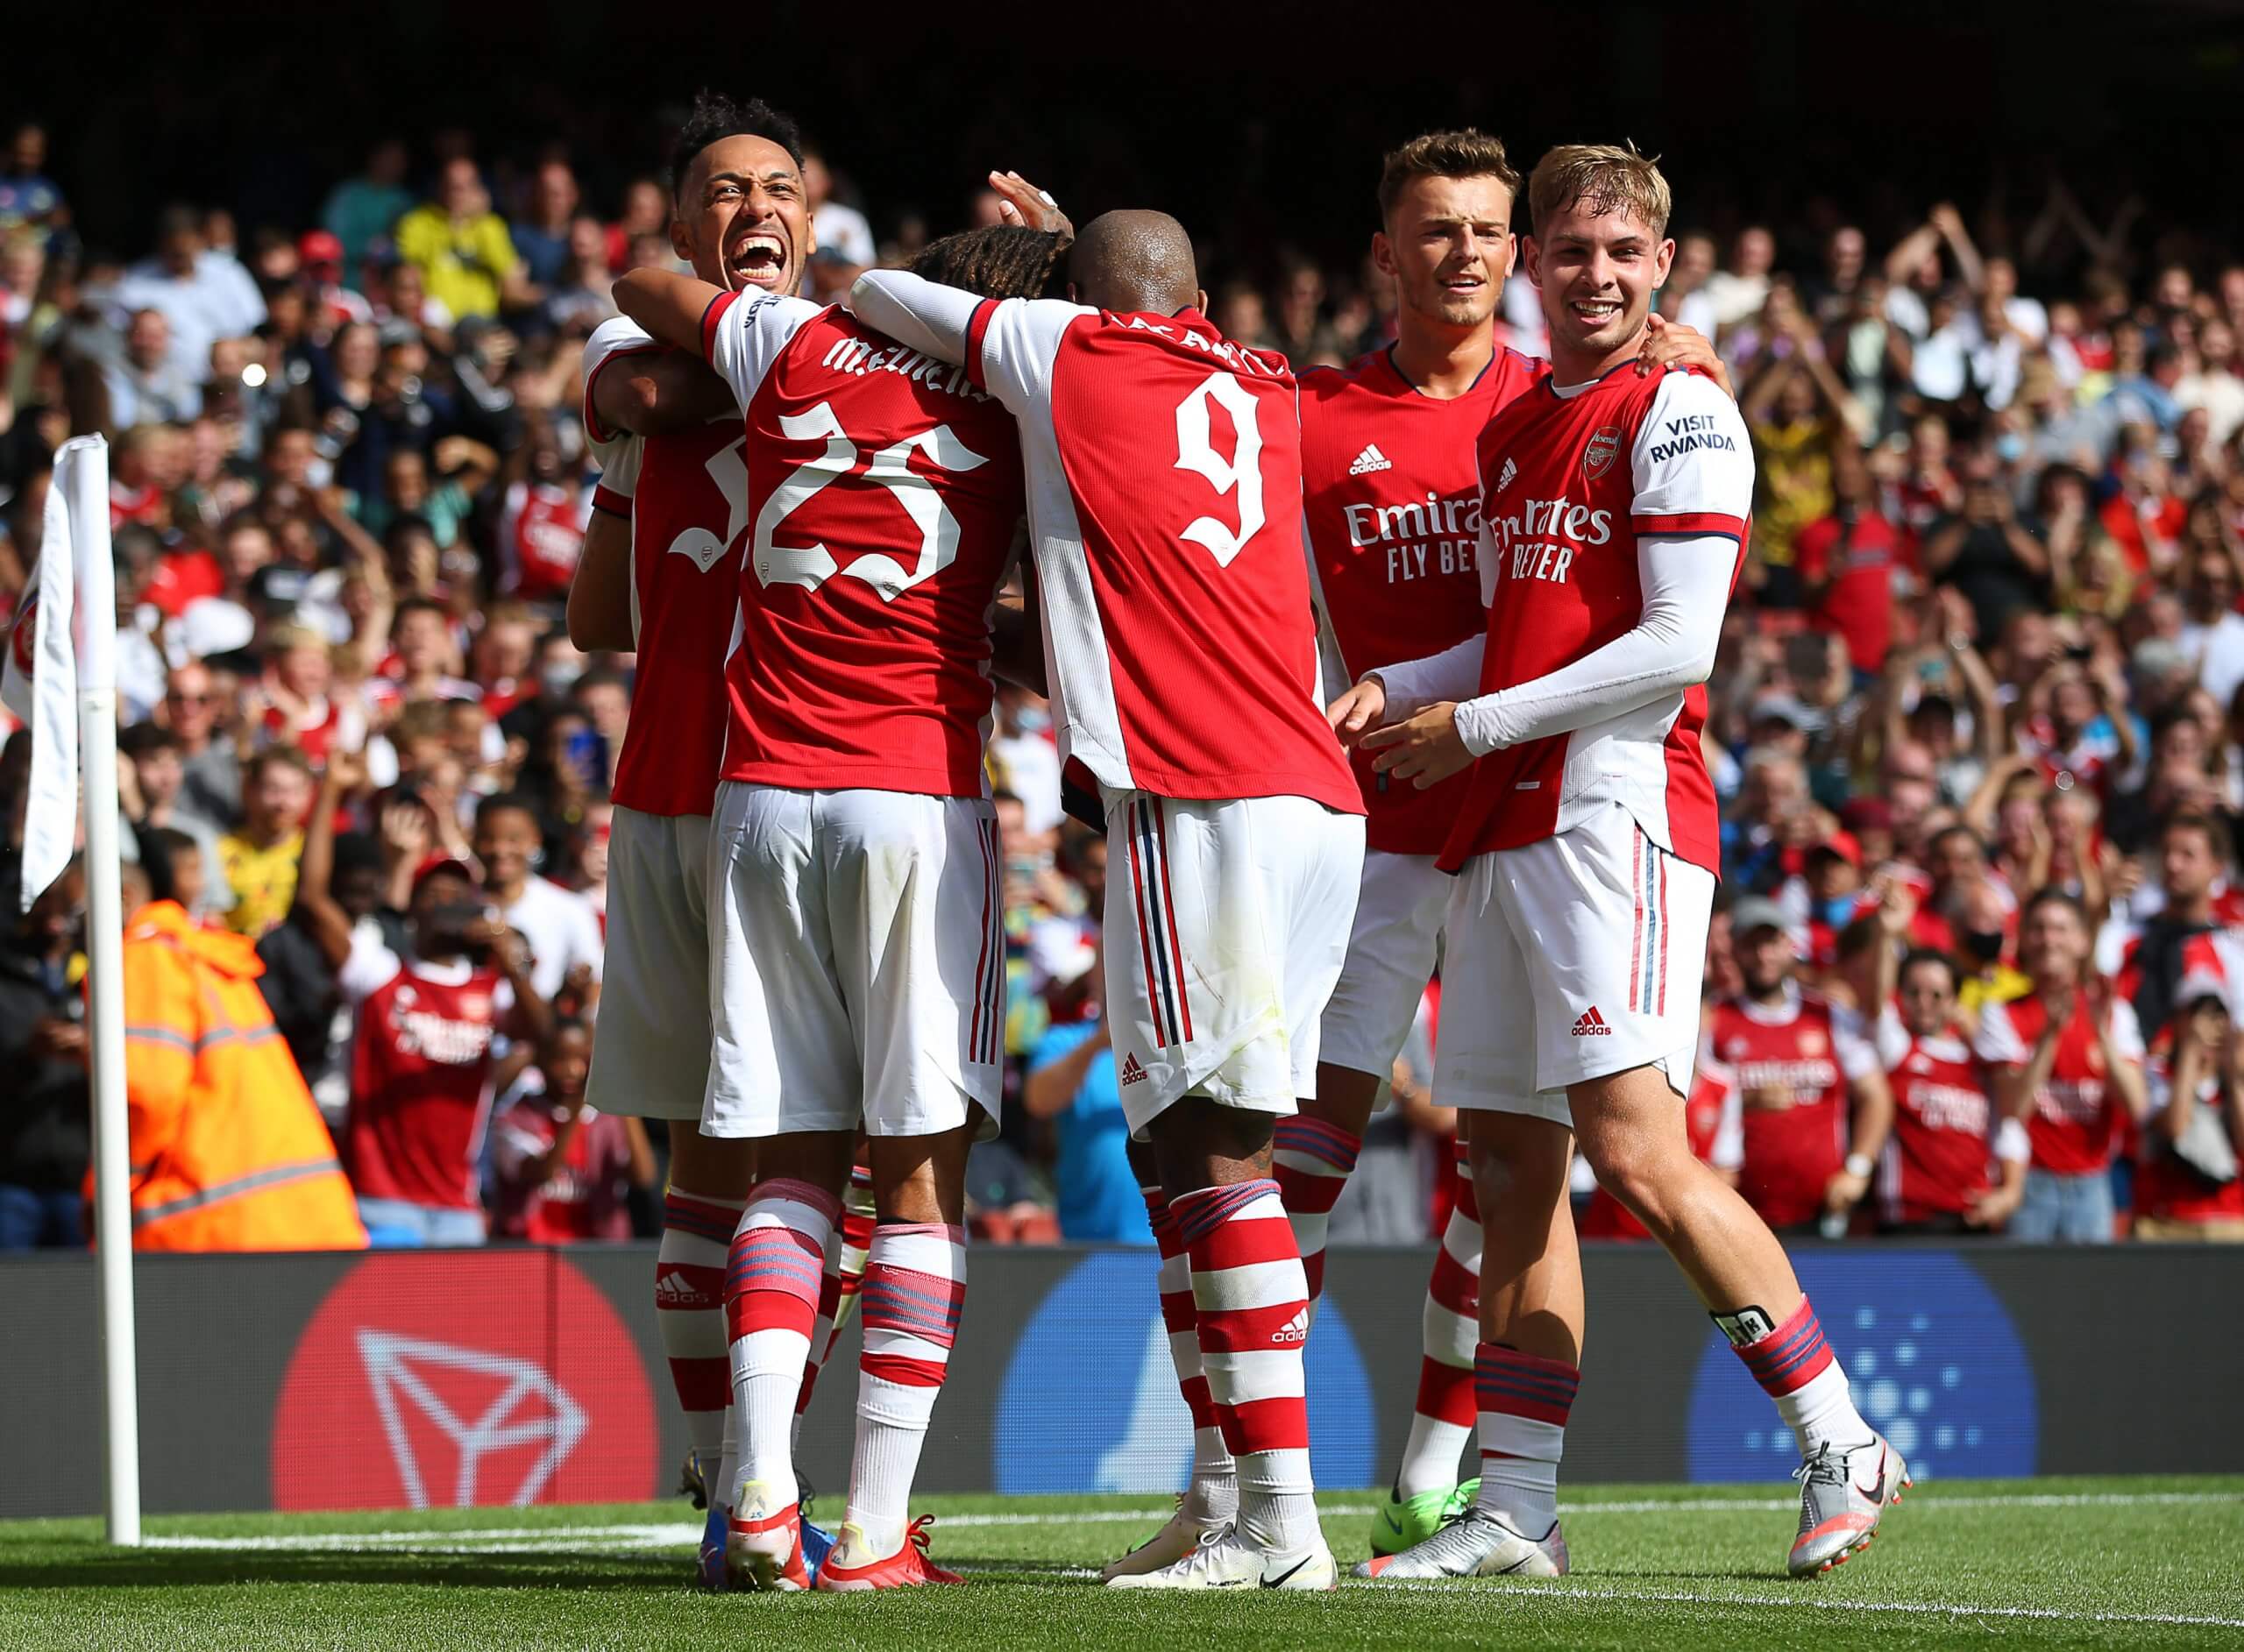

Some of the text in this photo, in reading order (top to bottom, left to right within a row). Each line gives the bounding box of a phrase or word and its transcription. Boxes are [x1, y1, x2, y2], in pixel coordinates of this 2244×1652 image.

[1665, 415, 1715, 436] VISIT
[1650, 433, 1736, 464] RWANDA
[1173, 372, 1267, 569] 9
[1349, 459, 1392, 476] adidas
[753, 401, 991, 603] 25
[1343, 491, 1481, 547] Emira
[1387, 539, 1480, 584] FLY BET
[1571, 1024, 1612, 1037] adidas
[1122, 1069, 1148, 1087] adidas
[657, 1290, 709, 1303] didas
[1271, 1329, 1307, 1343] adid
